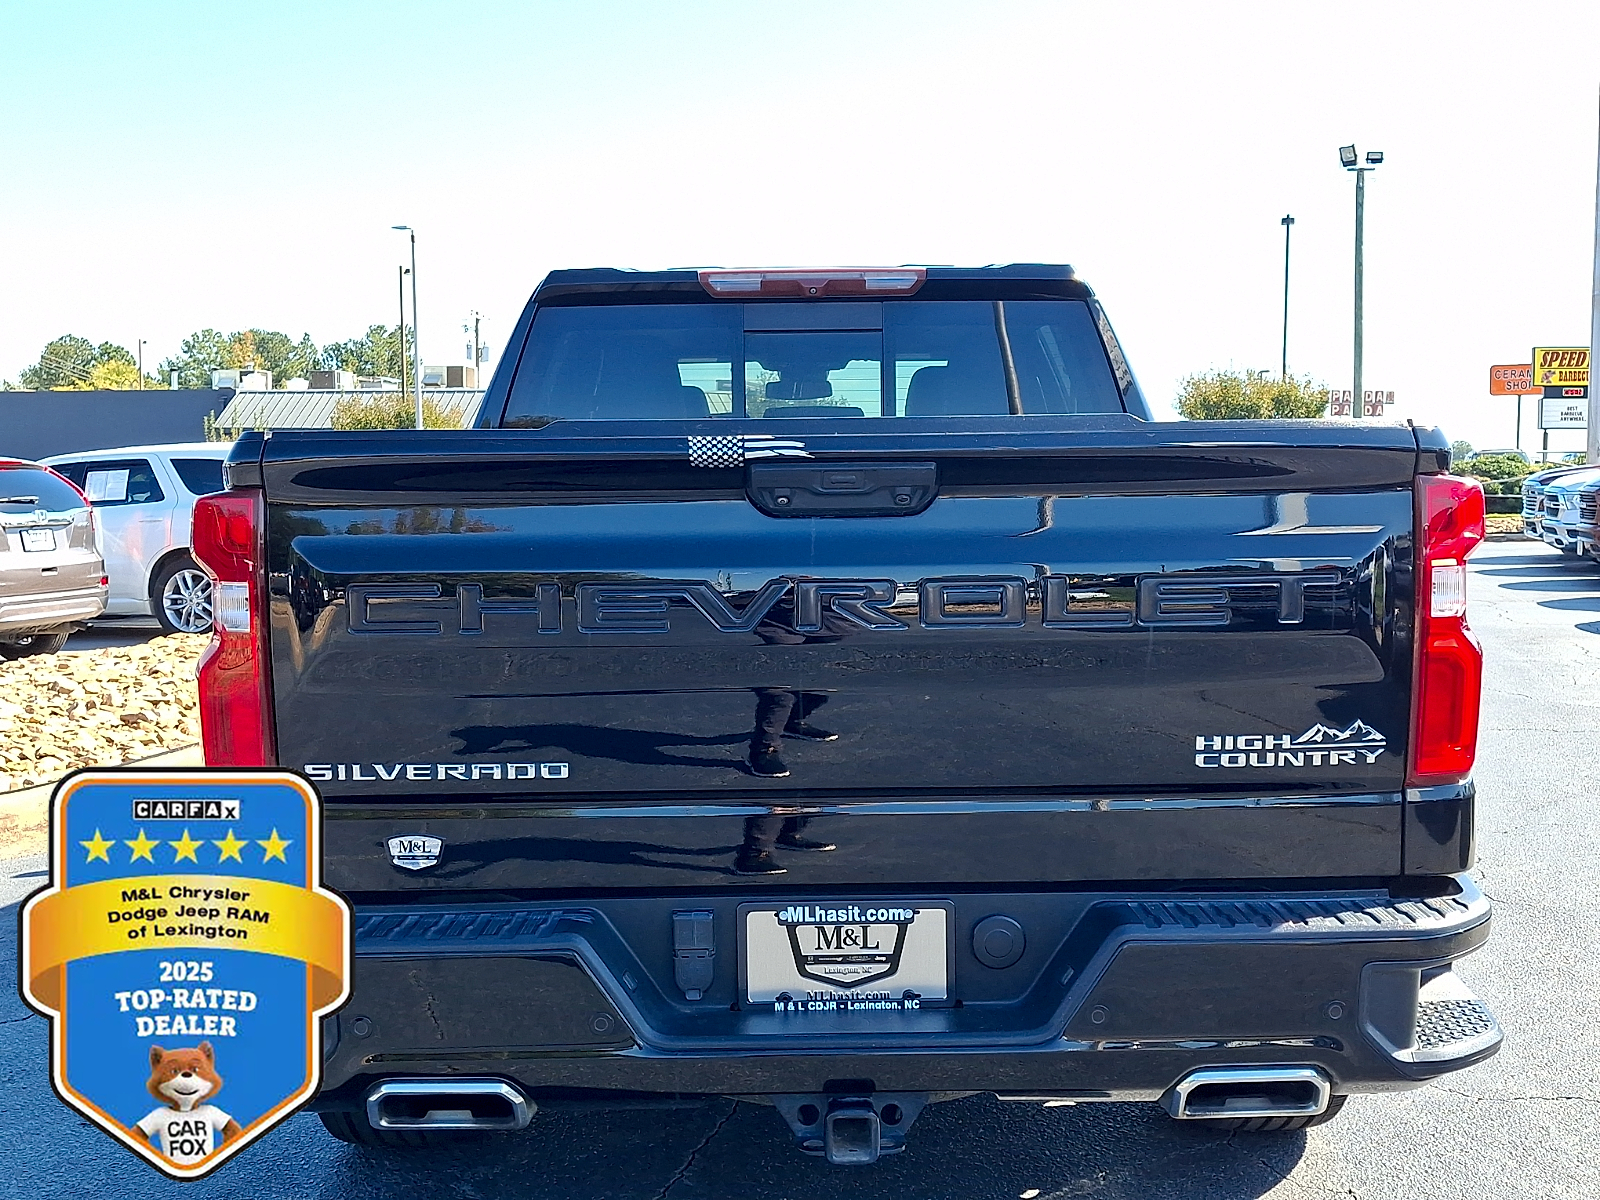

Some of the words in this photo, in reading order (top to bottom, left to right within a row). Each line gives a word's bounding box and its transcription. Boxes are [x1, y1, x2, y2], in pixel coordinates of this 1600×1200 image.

[1540, 351, 1590, 368] SPEED
[1332, 391, 1383, 402] PADA
[1331, 405, 1383, 416] PADA
[347, 569, 1342, 634] CHEVROLET
[1195, 734, 1292, 751] HIGH
[1195, 749, 1386, 768] COUNTRY
[304, 762, 570, 781] SILVERADO
[398, 839, 432, 854] M&L
[787, 906, 905, 923] MLhasit.com
[814, 925, 880, 950] M&L
[774, 1001, 785, 1011] M
[798, 1001, 805, 1011] L
[807, 1001, 837, 1011] CDJR
[904, 1000, 920, 1010] NC
